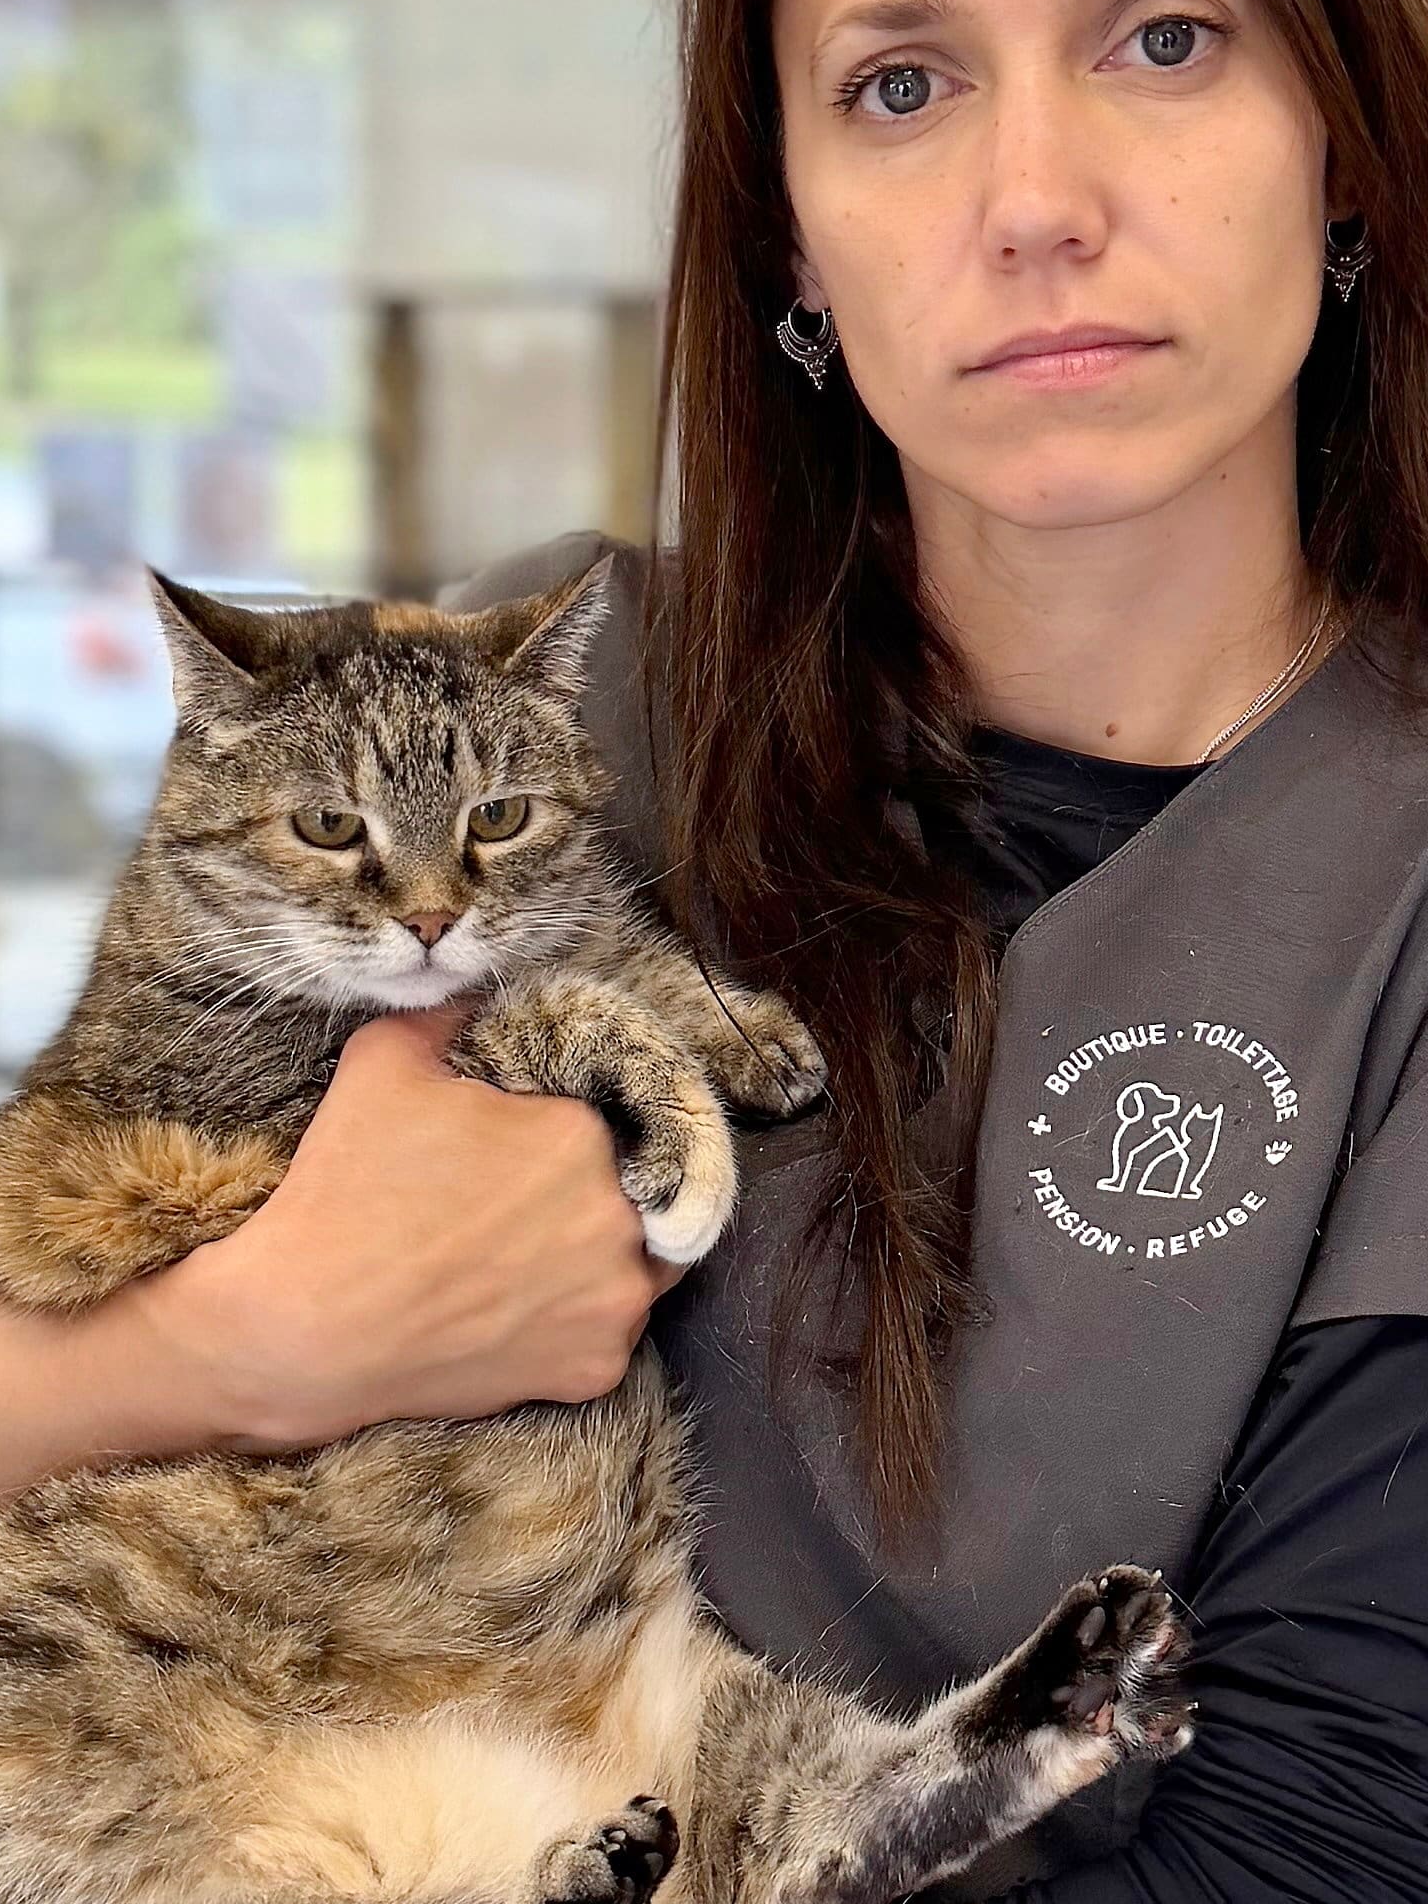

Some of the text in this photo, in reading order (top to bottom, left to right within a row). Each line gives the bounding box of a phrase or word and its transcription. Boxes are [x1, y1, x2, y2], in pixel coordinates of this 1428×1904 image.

[1044, 1021, 1300, 1124] BOUTIQUE TOILETTAGE
[1028, 1166, 1268, 1259] PENSION REFUGE
